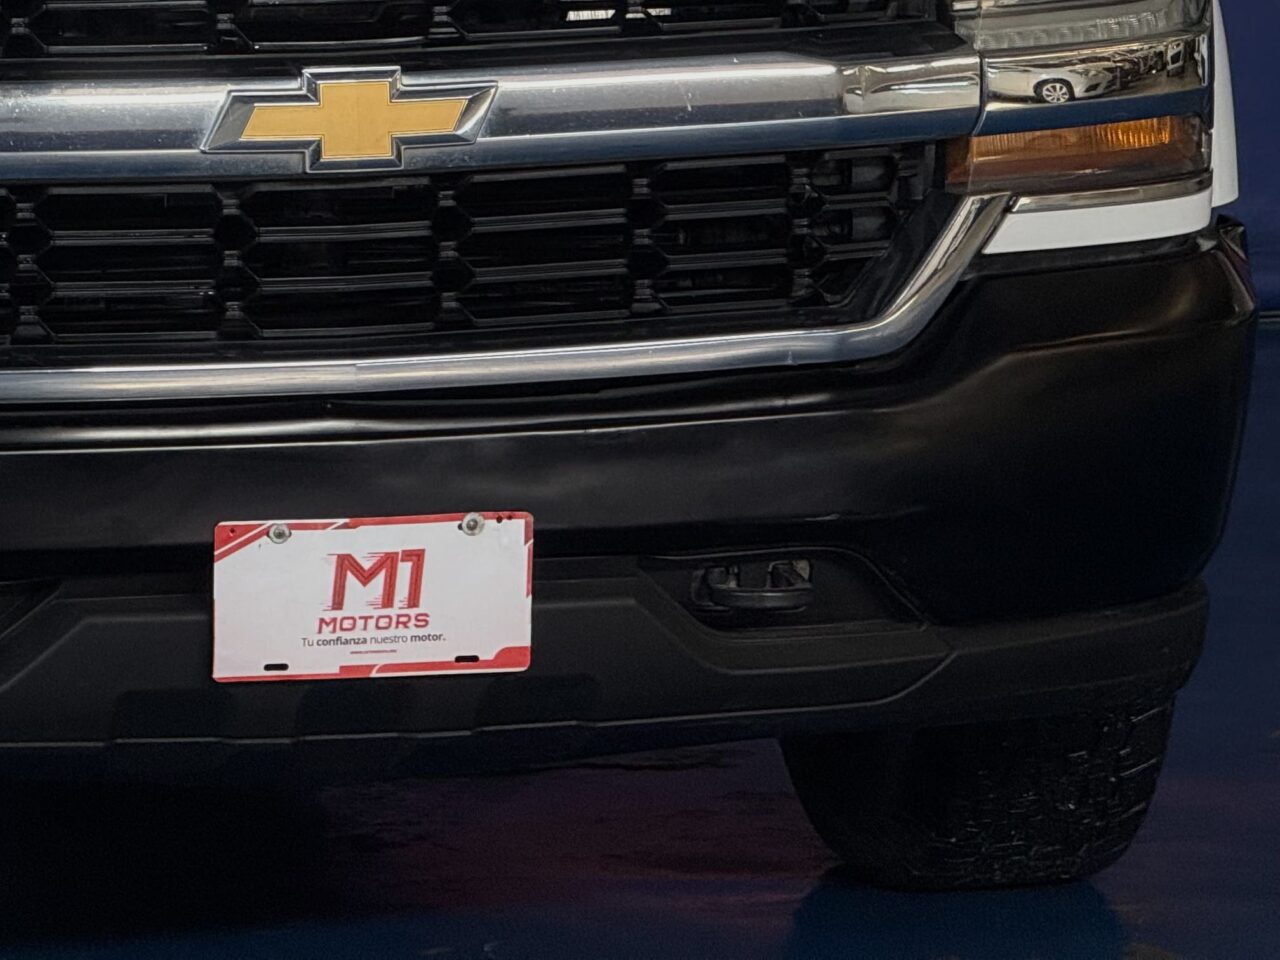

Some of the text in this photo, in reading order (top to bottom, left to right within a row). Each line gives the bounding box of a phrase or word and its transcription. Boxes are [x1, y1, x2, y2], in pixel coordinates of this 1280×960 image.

[317, 612, 430, 635] MOTORS
[301, 633, 447, 648] Tu confianza nuestro motor.
